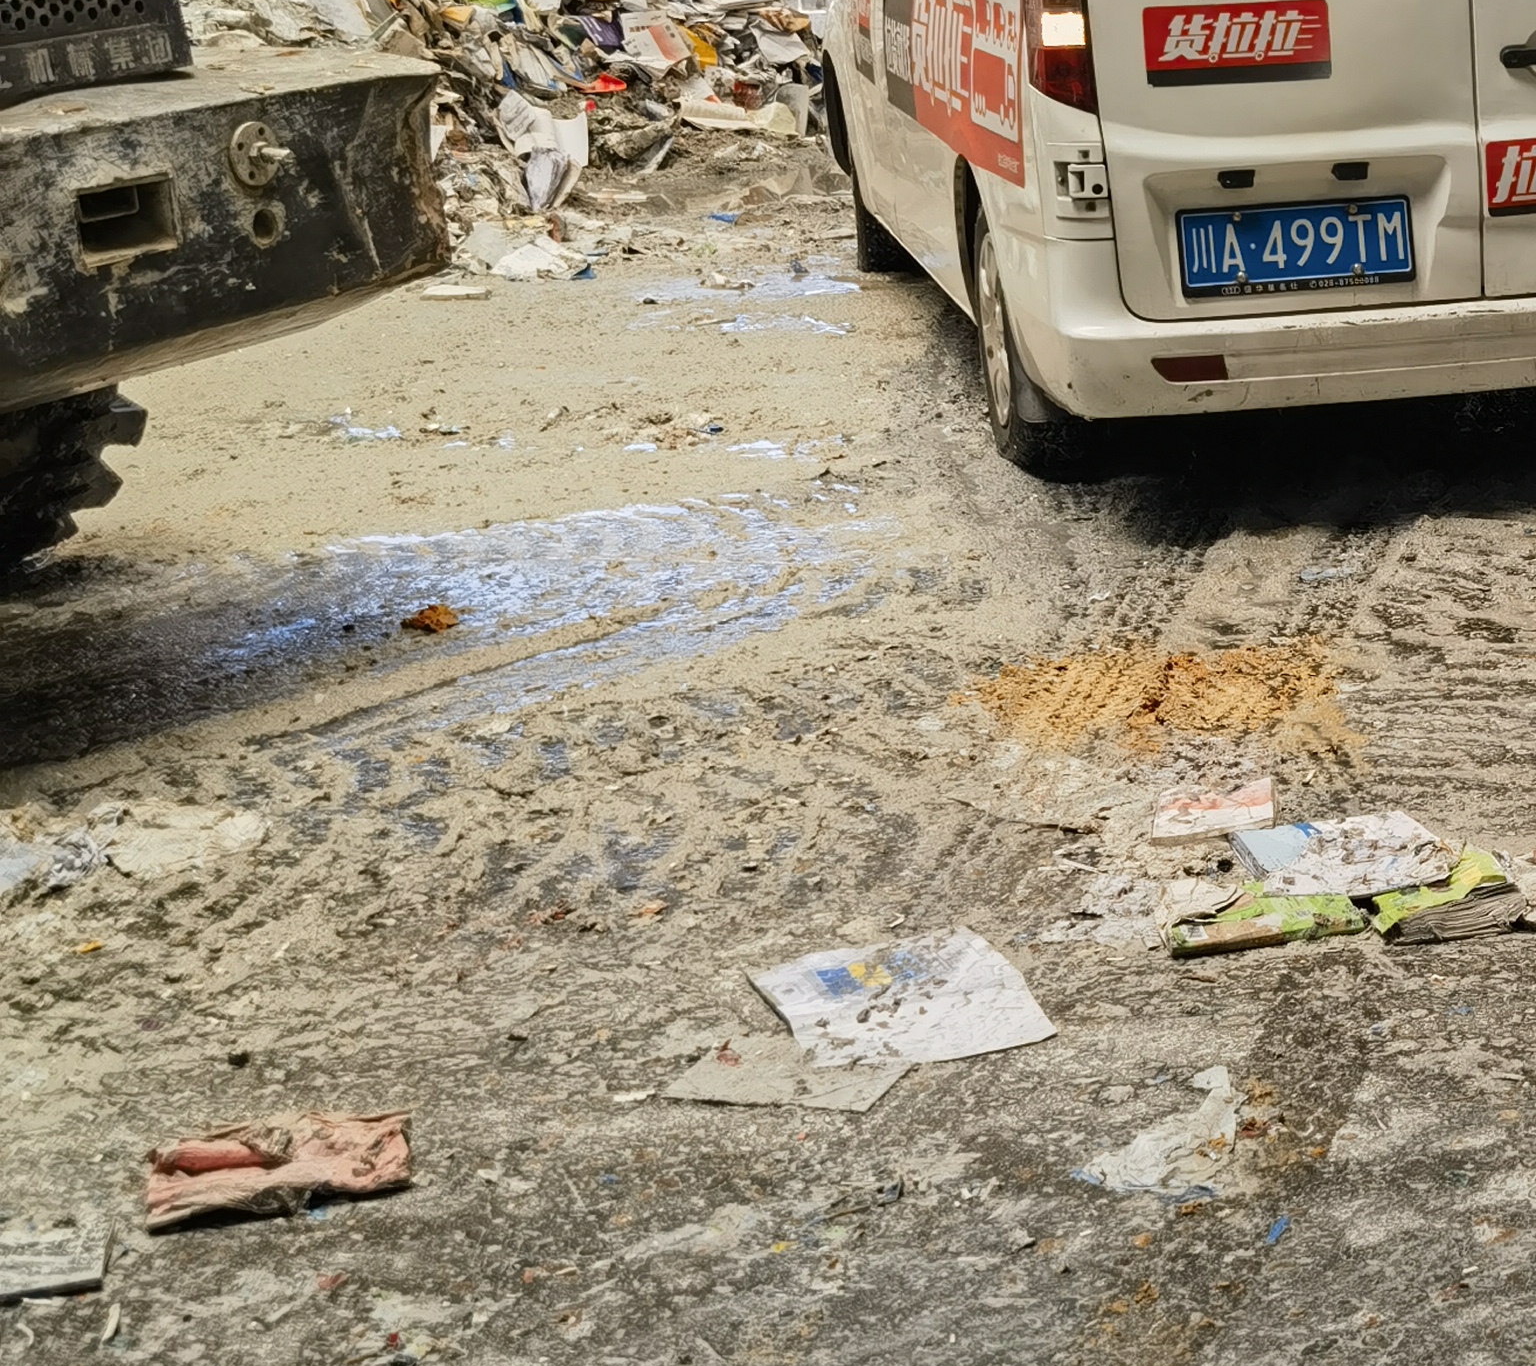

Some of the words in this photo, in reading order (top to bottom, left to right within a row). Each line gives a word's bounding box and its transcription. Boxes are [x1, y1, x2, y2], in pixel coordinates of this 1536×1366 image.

[1158, 9, 1310, 64] 货拉拉
[1191, 211, 1405, 274] 川A·499TM
